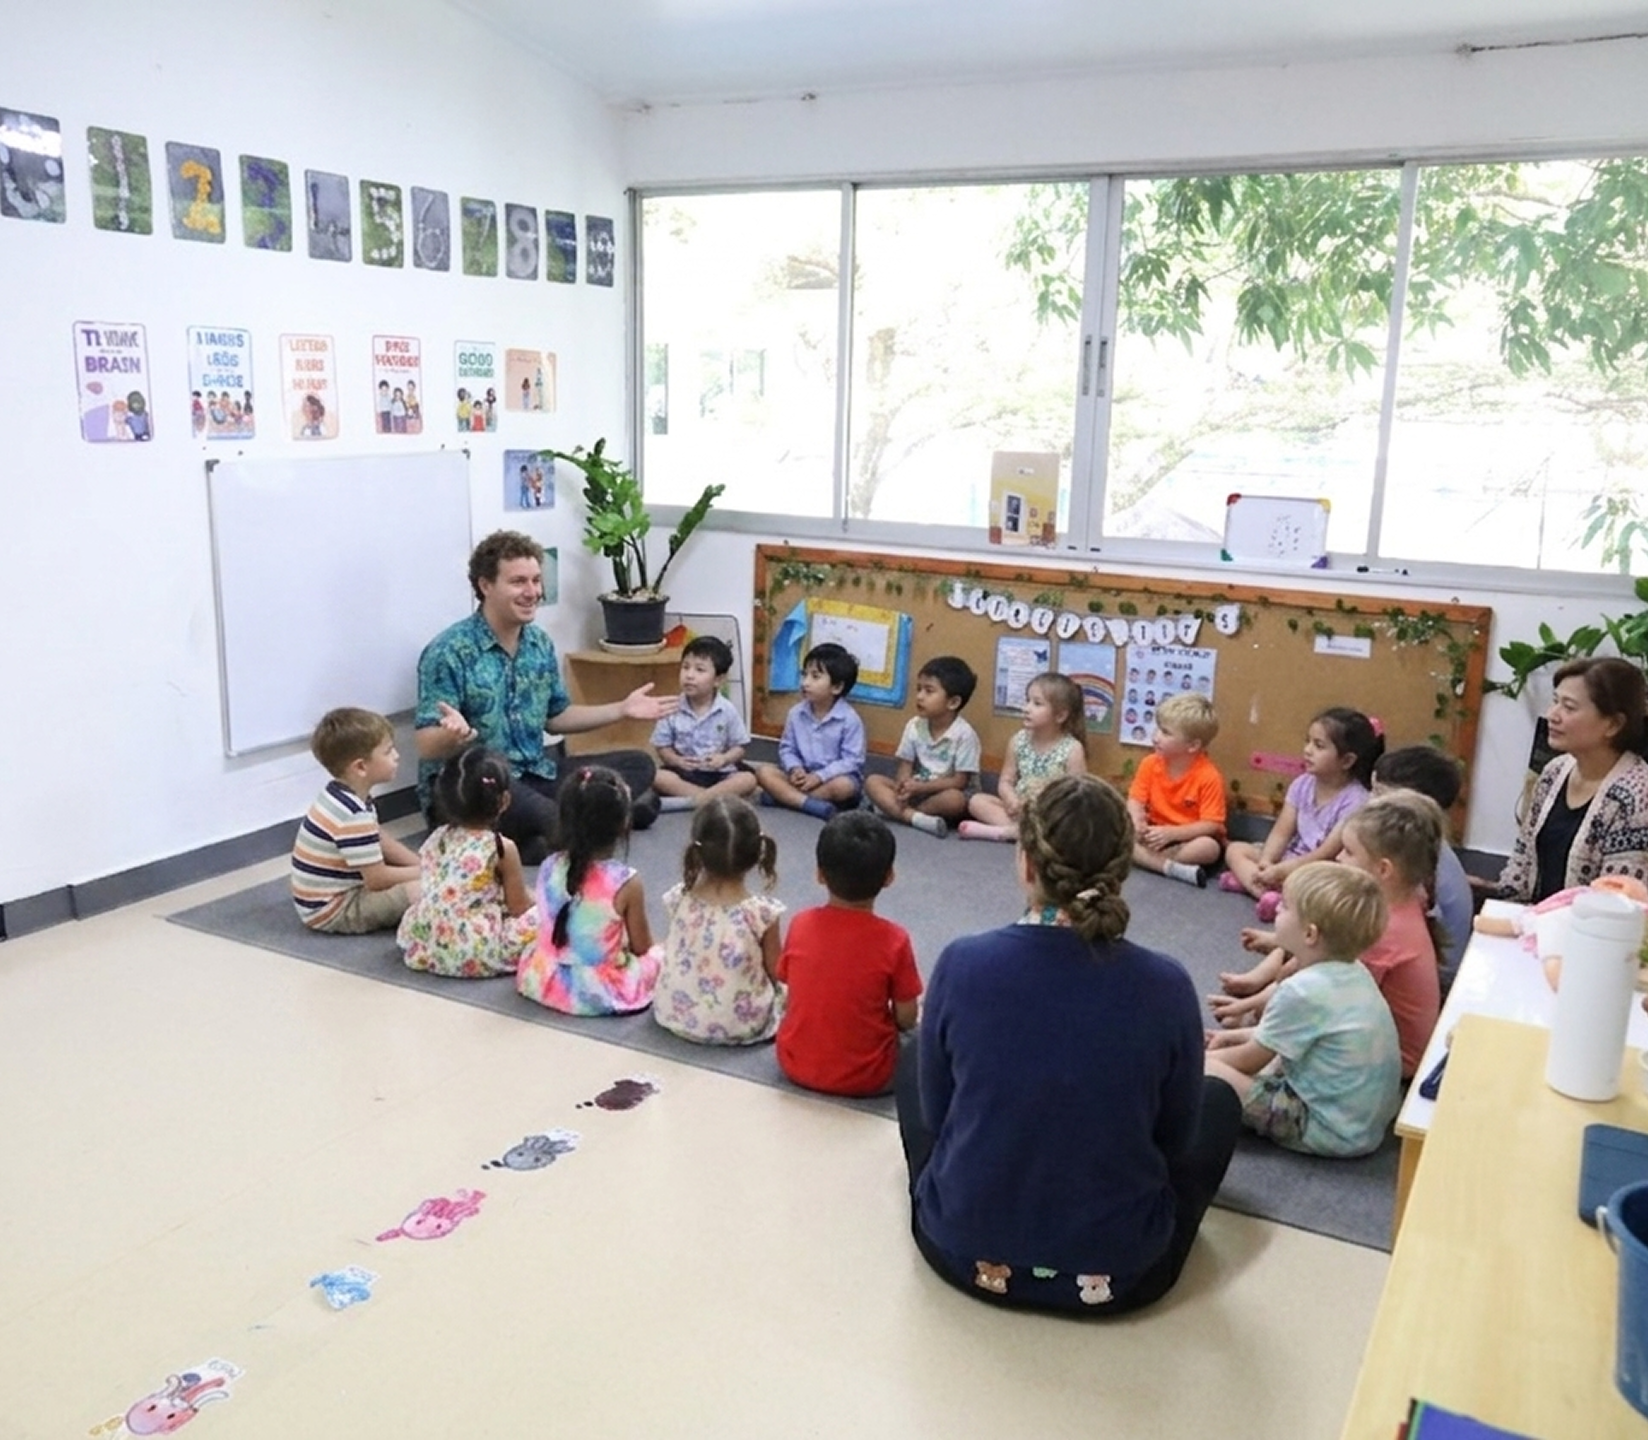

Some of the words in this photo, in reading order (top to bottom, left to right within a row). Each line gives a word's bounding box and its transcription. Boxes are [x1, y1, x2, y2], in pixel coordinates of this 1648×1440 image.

[180, 160, 222, 234] 2
[369, 187, 402, 260] 5
[416, 193, 446, 268] 6
[509, 208, 537, 277] 8
